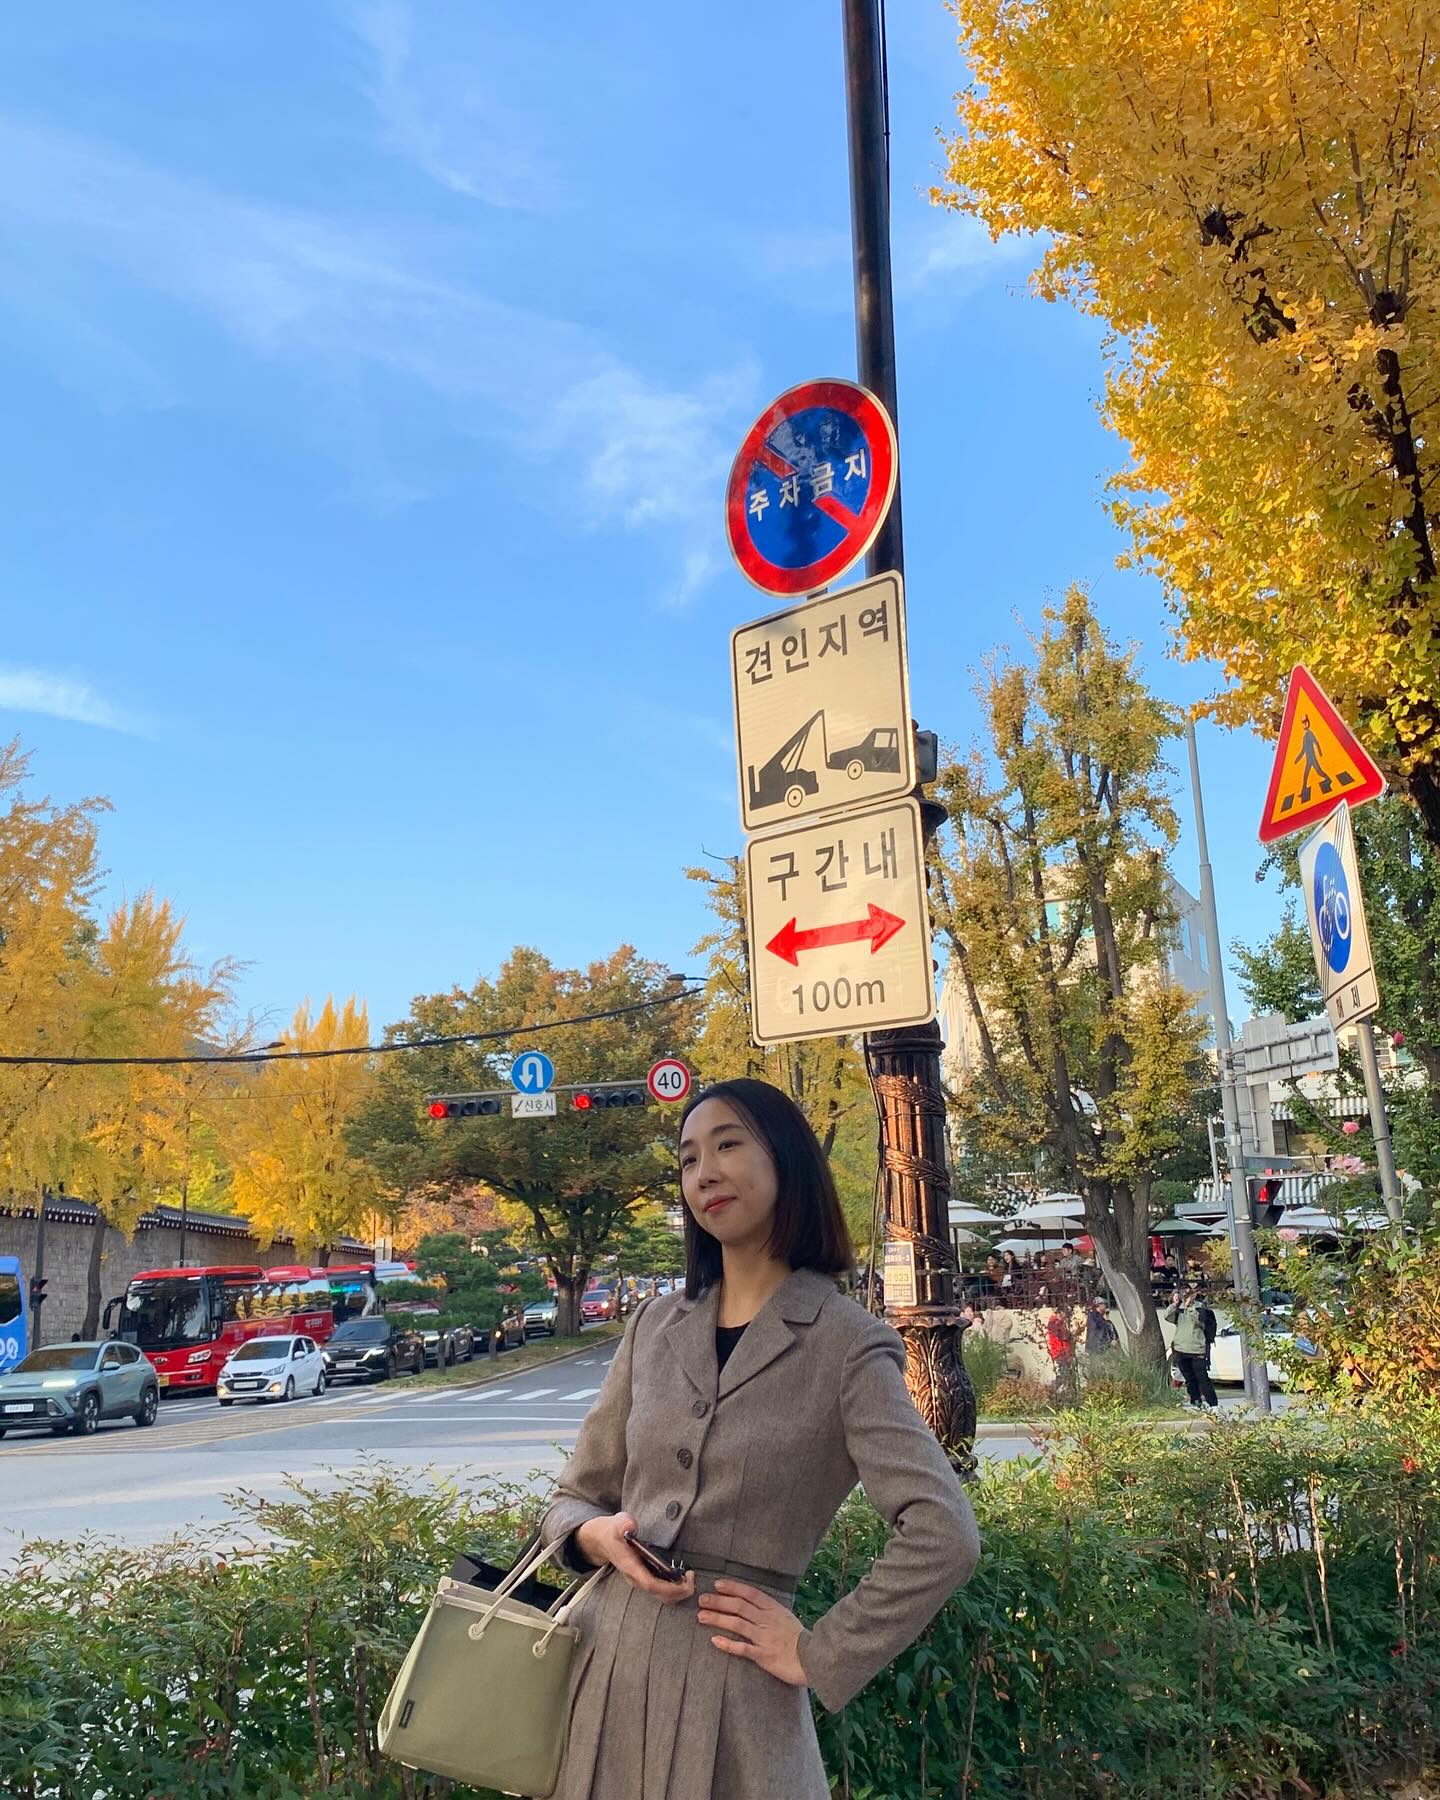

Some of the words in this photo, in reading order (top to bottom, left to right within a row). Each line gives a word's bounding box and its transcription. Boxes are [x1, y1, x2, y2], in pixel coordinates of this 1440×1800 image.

[749, 448, 866, 522] 주차금지
[745, 600, 889, 685] 견인지역
[767, 827, 898, 902] 구간내
[792, 976, 886, 1015] 100m
[525, 1098, 554, 1113] 신호시
[657, 1071, 682, 1090] 40
